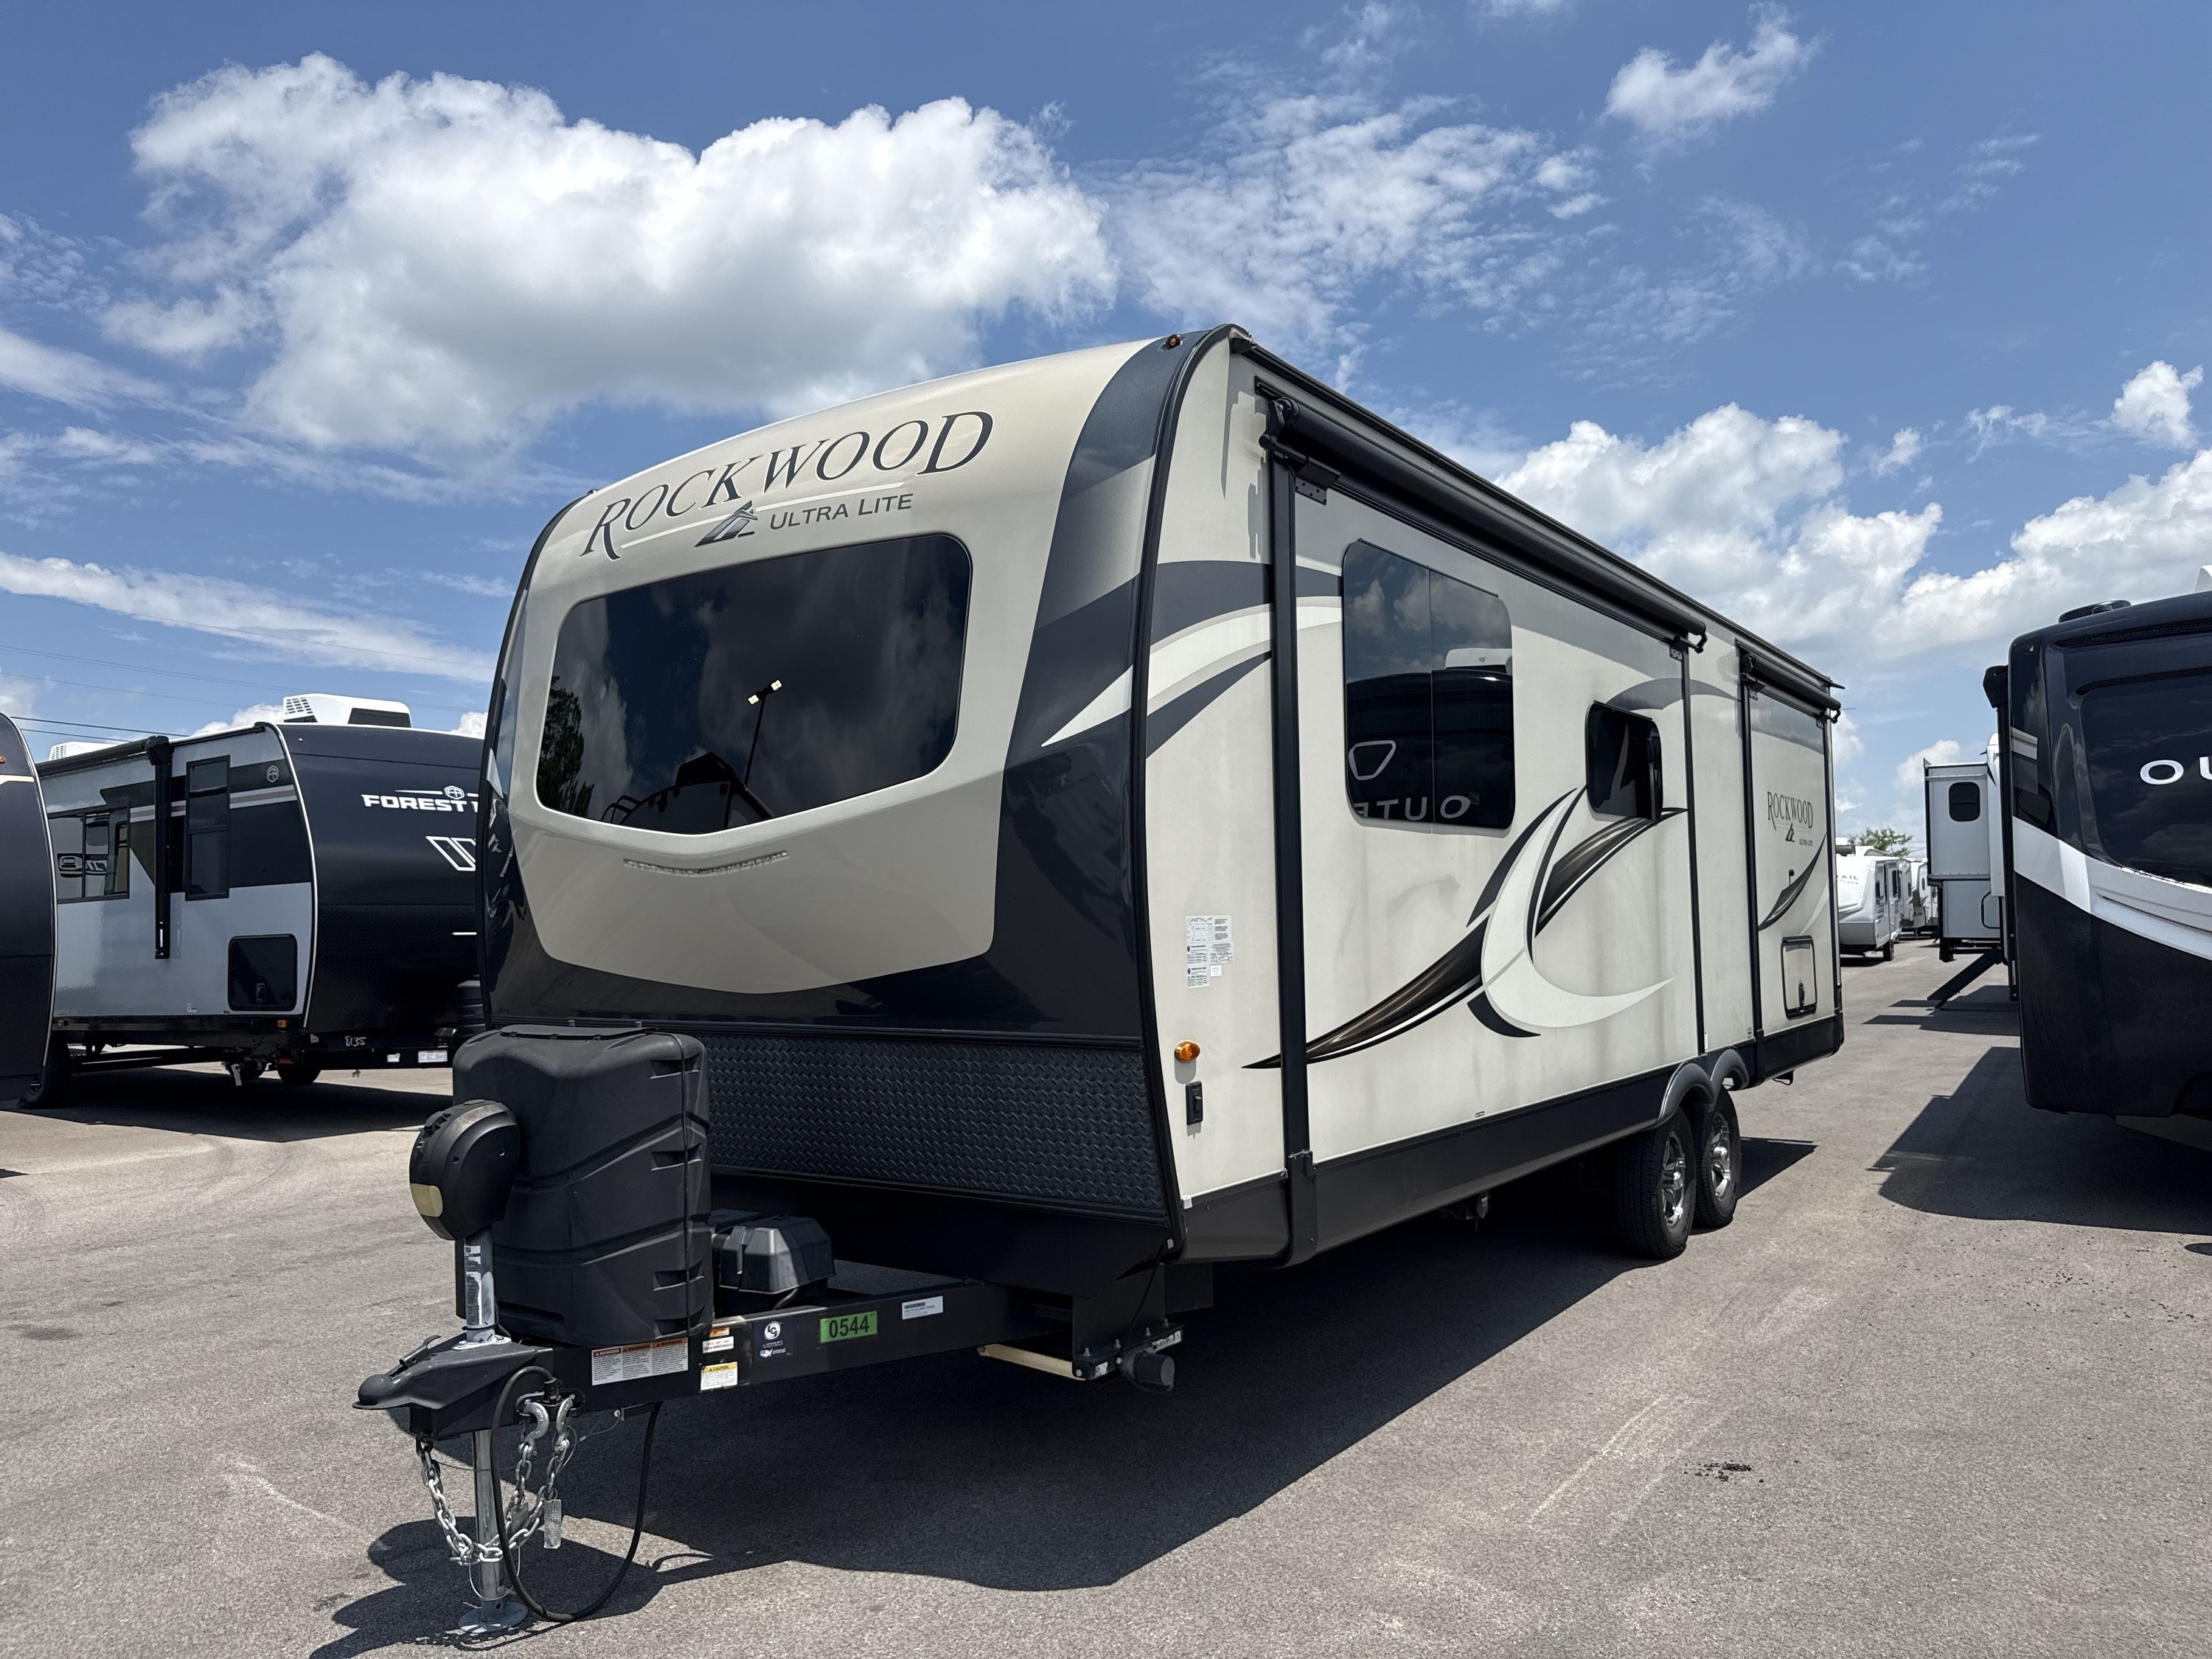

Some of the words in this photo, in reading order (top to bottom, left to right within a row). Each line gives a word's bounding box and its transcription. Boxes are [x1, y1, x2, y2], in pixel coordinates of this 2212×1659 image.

[578, 411, 994, 560] ROCKWOOD
[770, 504, 849, 529] ULTRA
[858, 493, 914, 515] LITE
[361, 794, 467, 812] FOREST
[1767, 791, 1813, 830] ROCKWOOD
[344, 1035, 366, 1047] 8135
[829, 1315, 869, 1338] 0544
